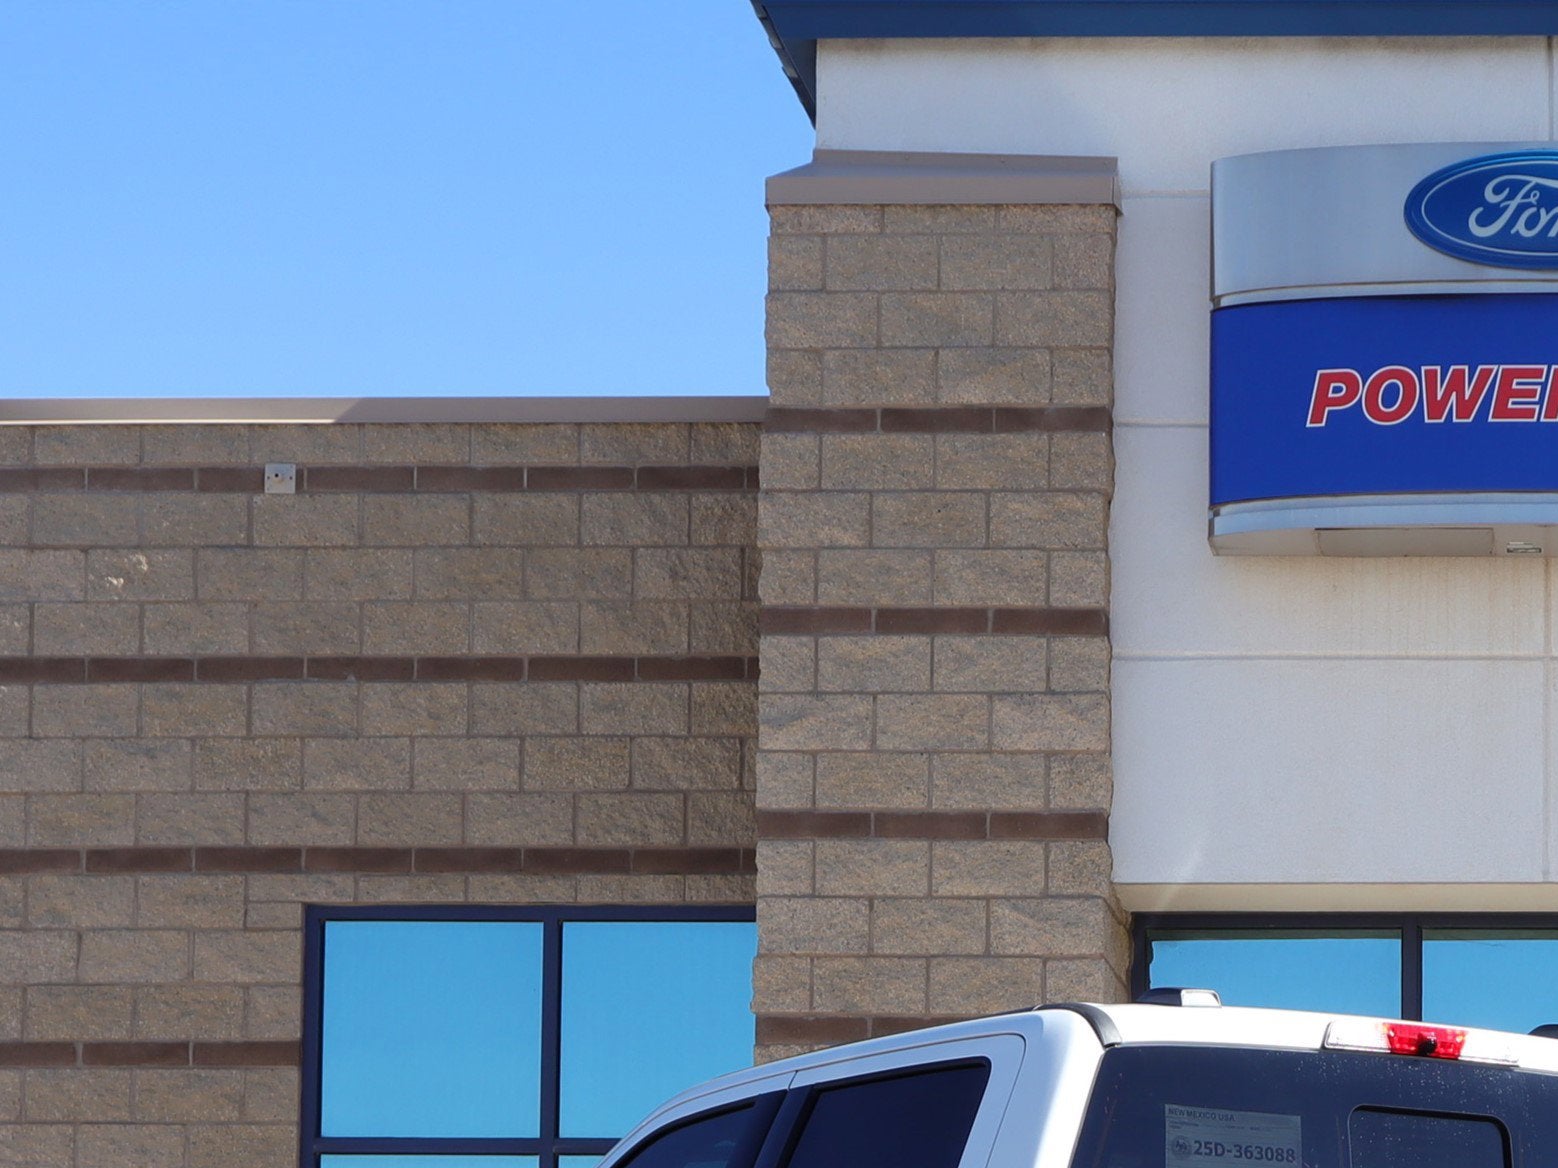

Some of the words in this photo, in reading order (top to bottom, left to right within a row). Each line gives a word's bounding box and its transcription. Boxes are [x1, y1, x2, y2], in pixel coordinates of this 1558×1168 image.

[1168, 1107, 1185, 1117] NEW
[1186, 1110, 1217, 1121] MEXICO
[1218, 1114, 1236, 1122] USA
[1193, 1140, 1296, 1163] 25D-363088
